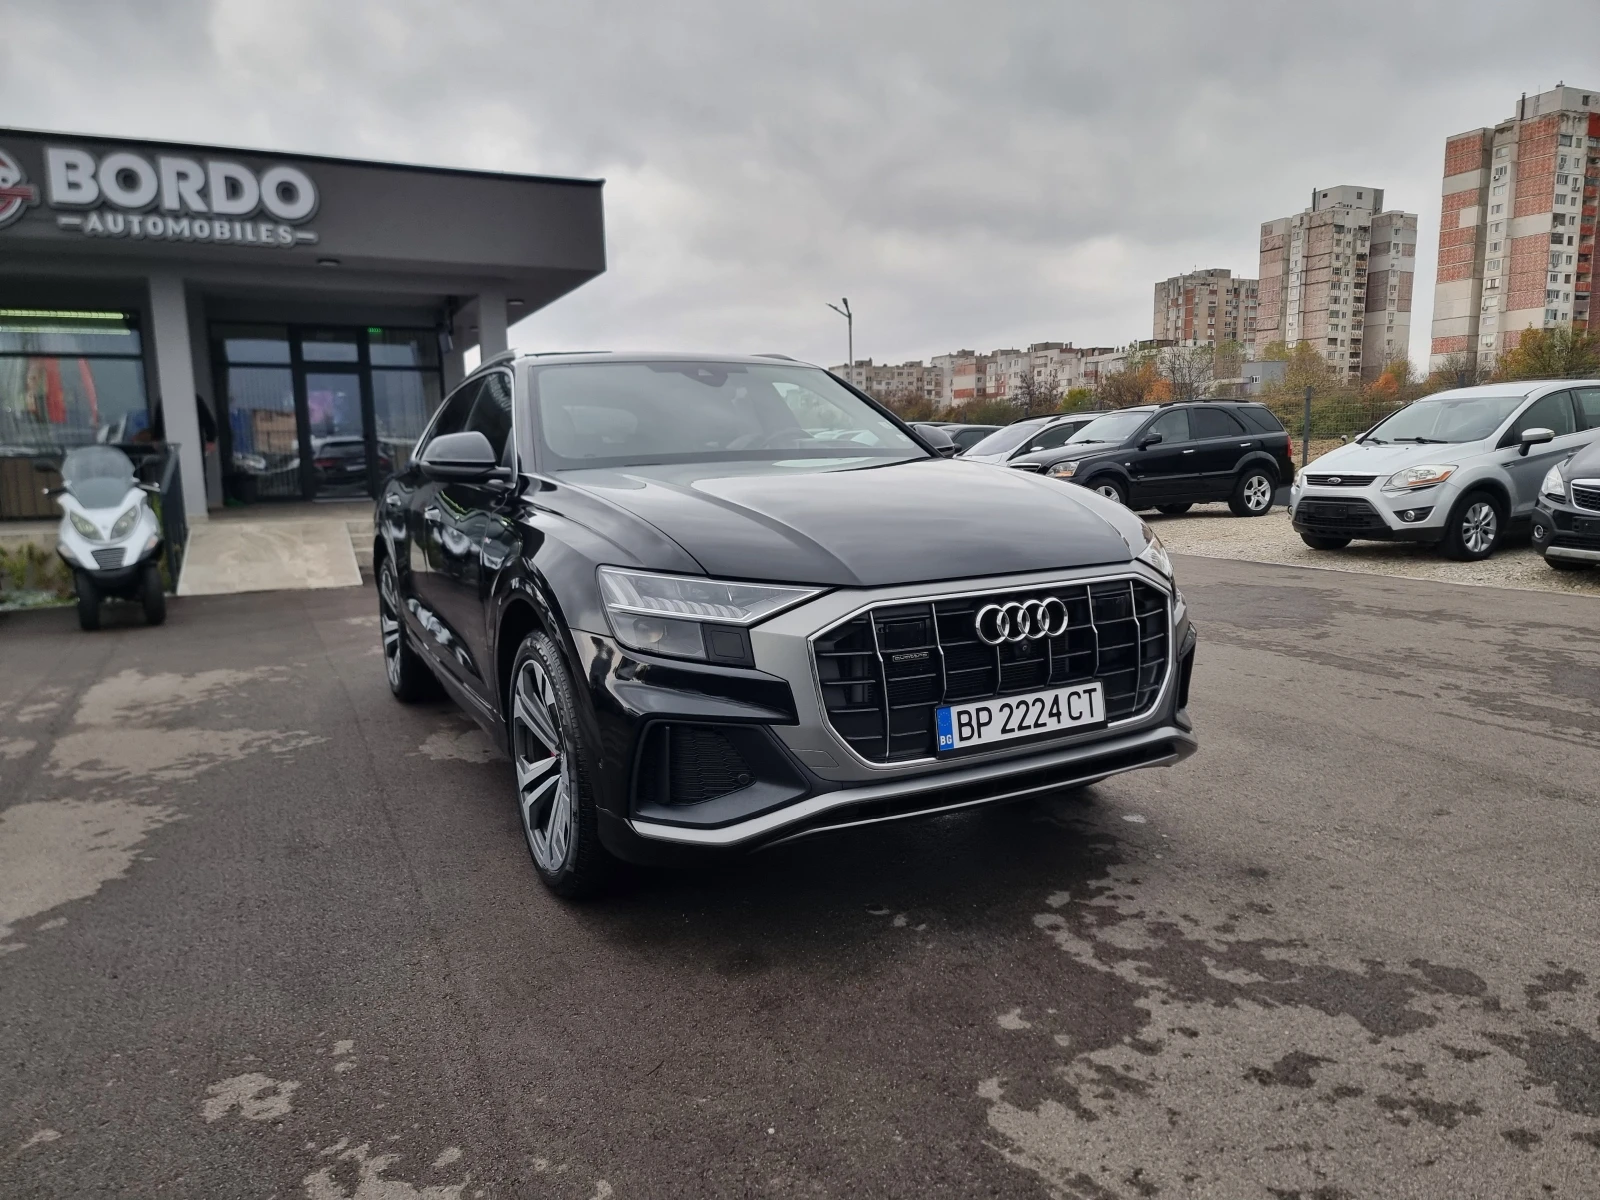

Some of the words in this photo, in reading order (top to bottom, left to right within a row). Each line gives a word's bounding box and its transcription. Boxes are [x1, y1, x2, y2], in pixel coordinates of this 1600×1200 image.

[47, 147, 316, 221] BORDO
[86, 212, 294, 245] AUTOMOBILES
[956, 706, 993, 742] BP
[999, 693, 1063, 735] 2224
[1067, 687, 1097, 721] CT
[939, 734, 953, 746] BG
